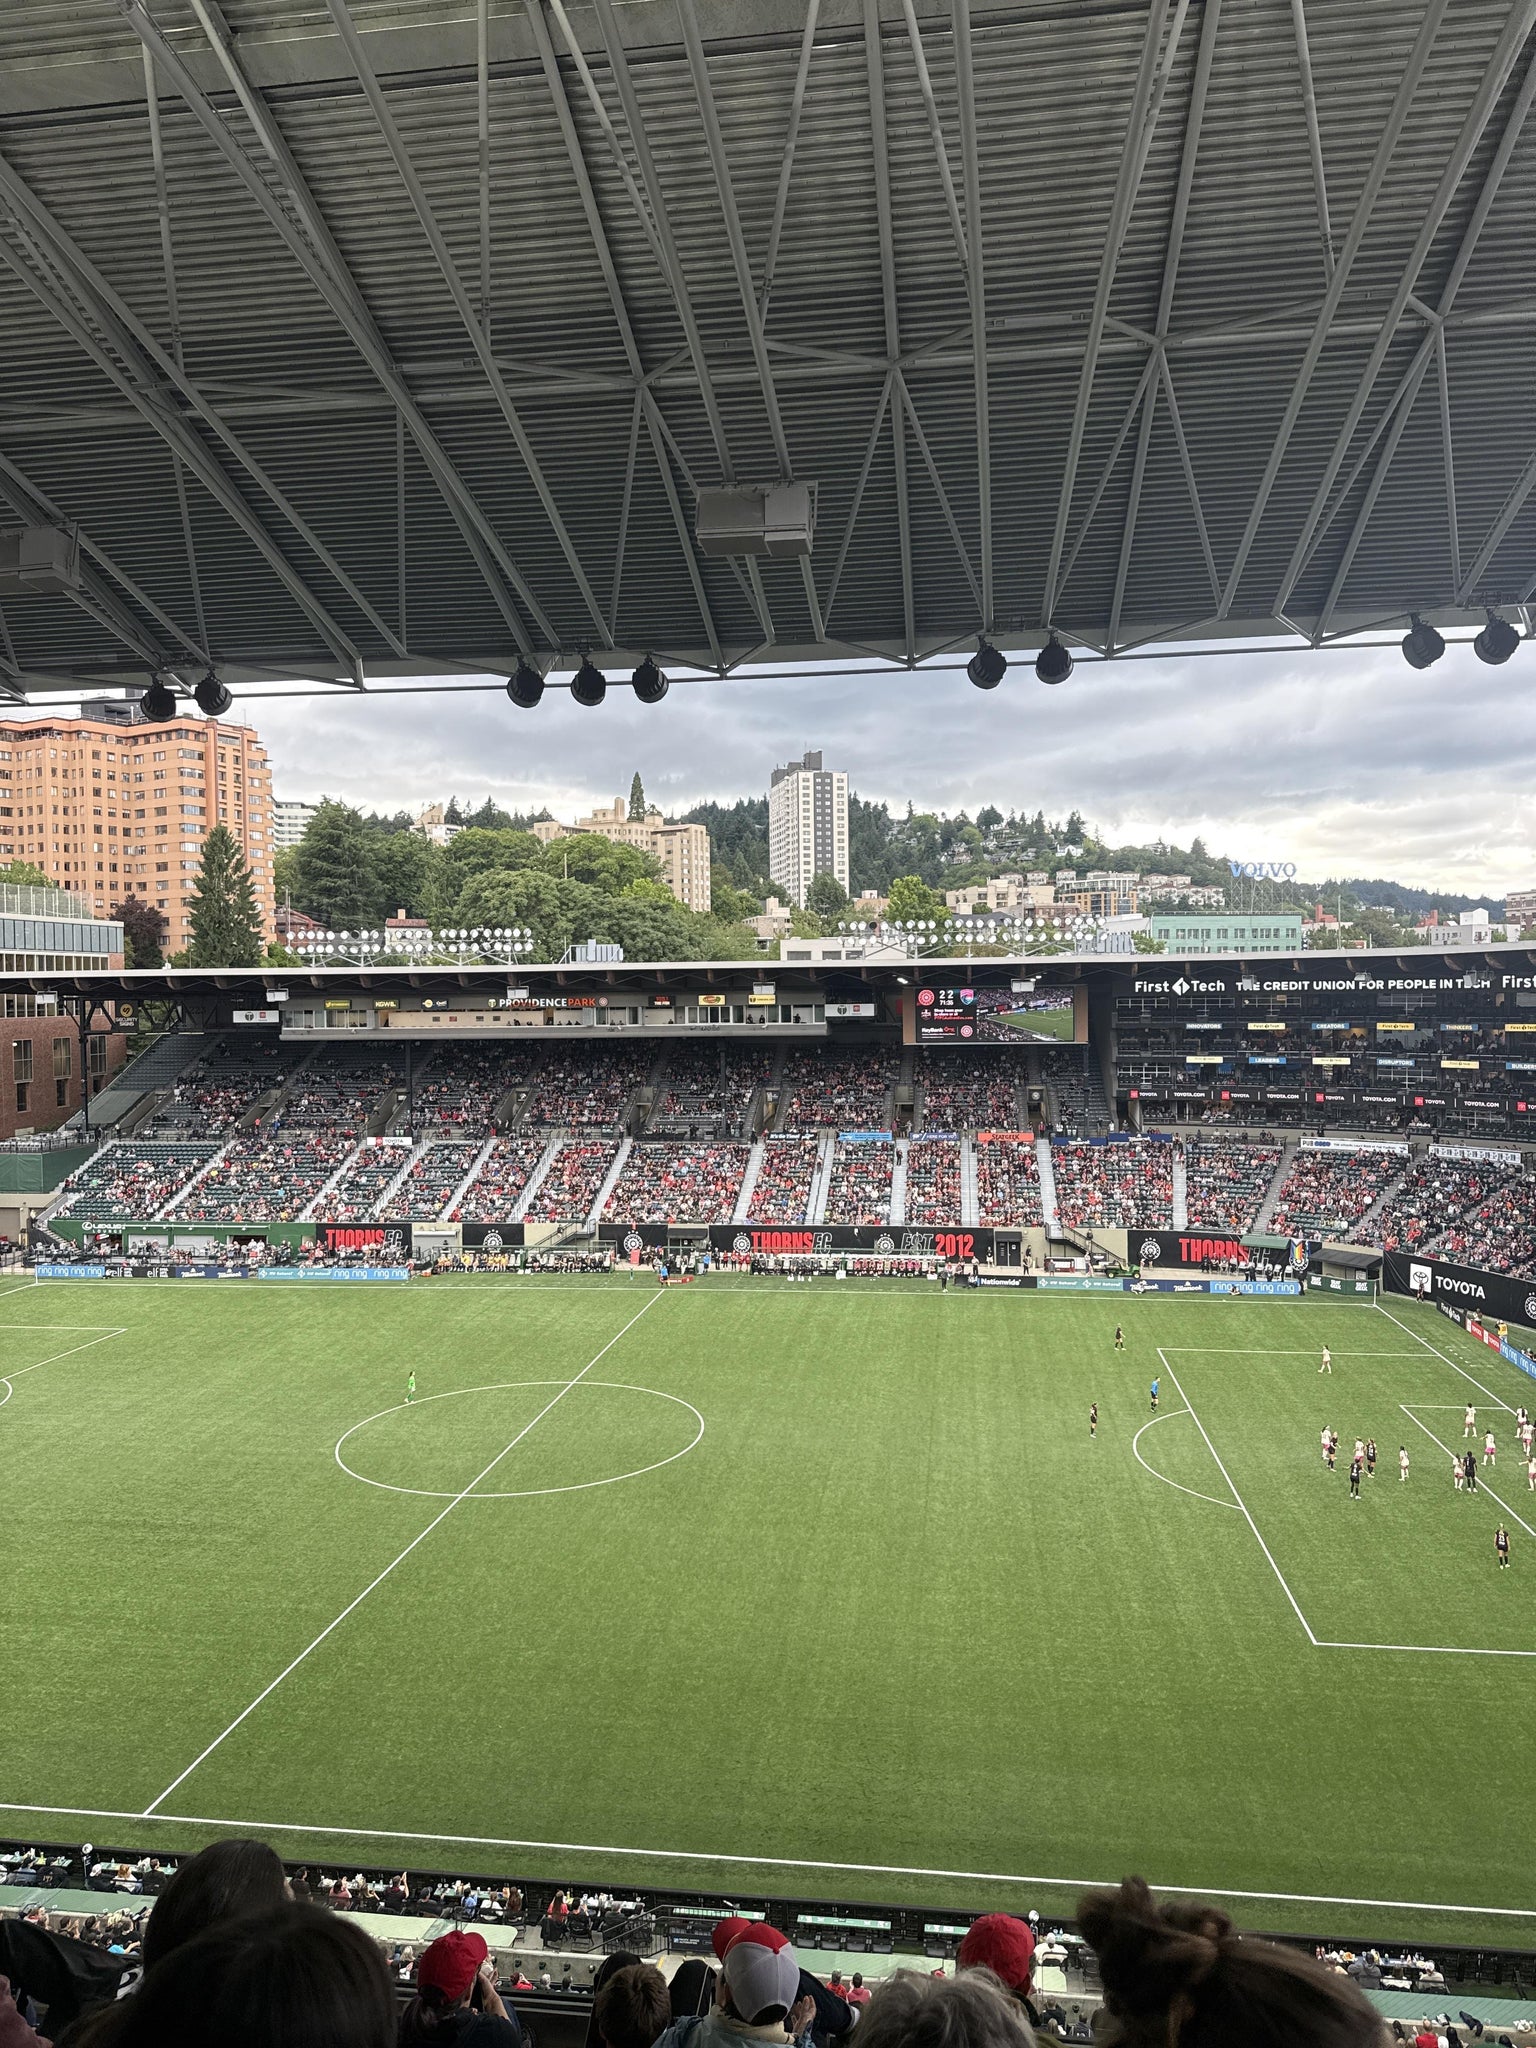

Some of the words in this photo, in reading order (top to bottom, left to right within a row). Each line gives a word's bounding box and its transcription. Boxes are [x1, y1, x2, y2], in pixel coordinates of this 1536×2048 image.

[1227, 862, 1297, 878] VOLVO
[1134, 980, 1170, 992] First
[1190, 979, 1226, 992] Tech
[1263, 980, 1311, 991] CREDIT
[1313, 979, 1355, 991] UNION
[1358, 979, 1385, 990] FOR
[1388, 978, 1437, 990] PEOPLE
[1439, 978, 1453, 989] IN
[939, 990, 946, 999] 2
[947, 990, 954, 999] 2
[499, 998, 567, 1008] PROVIDENCE
[568, 998, 596, 1007] PARK
[1464, 1100, 1500, 1108] TOYOTA.COM
[325, 1229, 385, 1251] THORNS
[751, 1231, 813, 1254] THORNS
[811, 1232, 833, 1255] FC
[901, 1233, 934, 1255] EST
[935, 1233, 974, 1257] 2012
[38, 1267, 53, 1277] ring
[54, 1267, 69, 1277] ring
[71, 1267, 85, 1277] ring
[87, 1267, 103, 1277] ring
[147, 1267, 159, 1278] elf
[334, 1270, 350, 1279] ring
[352, 1270, 367, 1279] ring
[373, 1270, 389, 1279] ring
[391, 1270, 407, 1279] ring
[980, 1278, 1020, 1286] Nationwide
[1435, 1275, 1486, 1299] TOYOTA
[1256, 1283, 1273, 1293] ring
[1277, 1283, 1294, 1293] ring
